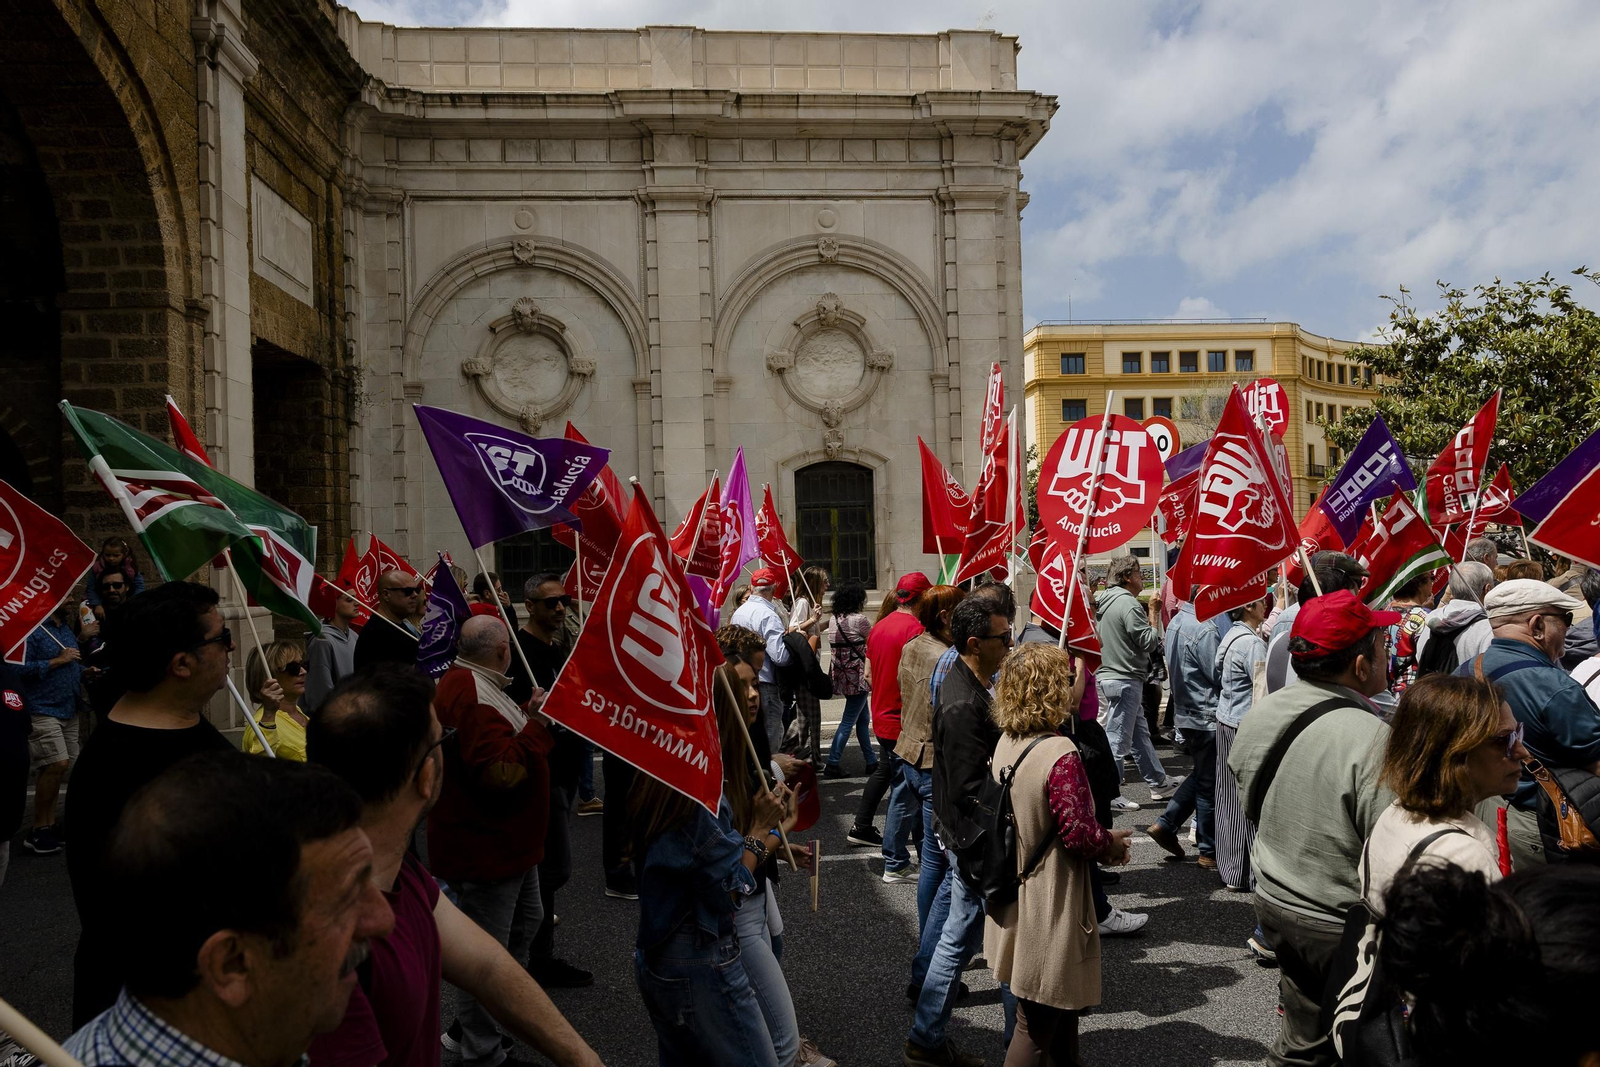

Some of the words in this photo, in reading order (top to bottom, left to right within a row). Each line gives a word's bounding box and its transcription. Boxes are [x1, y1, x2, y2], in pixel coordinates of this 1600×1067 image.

[478, 443, 536, 477] GT
[1057, 428, 1147, 482] UGT
[1156, 434, 1169, 452] 0
[1454, 415, 1476, 491] COO
[1443, 474, 1459, 516] Cádiz
[1056, 515, 1122, 538] Andlucía
[580, 688, 709, 775] www.ugt.es
